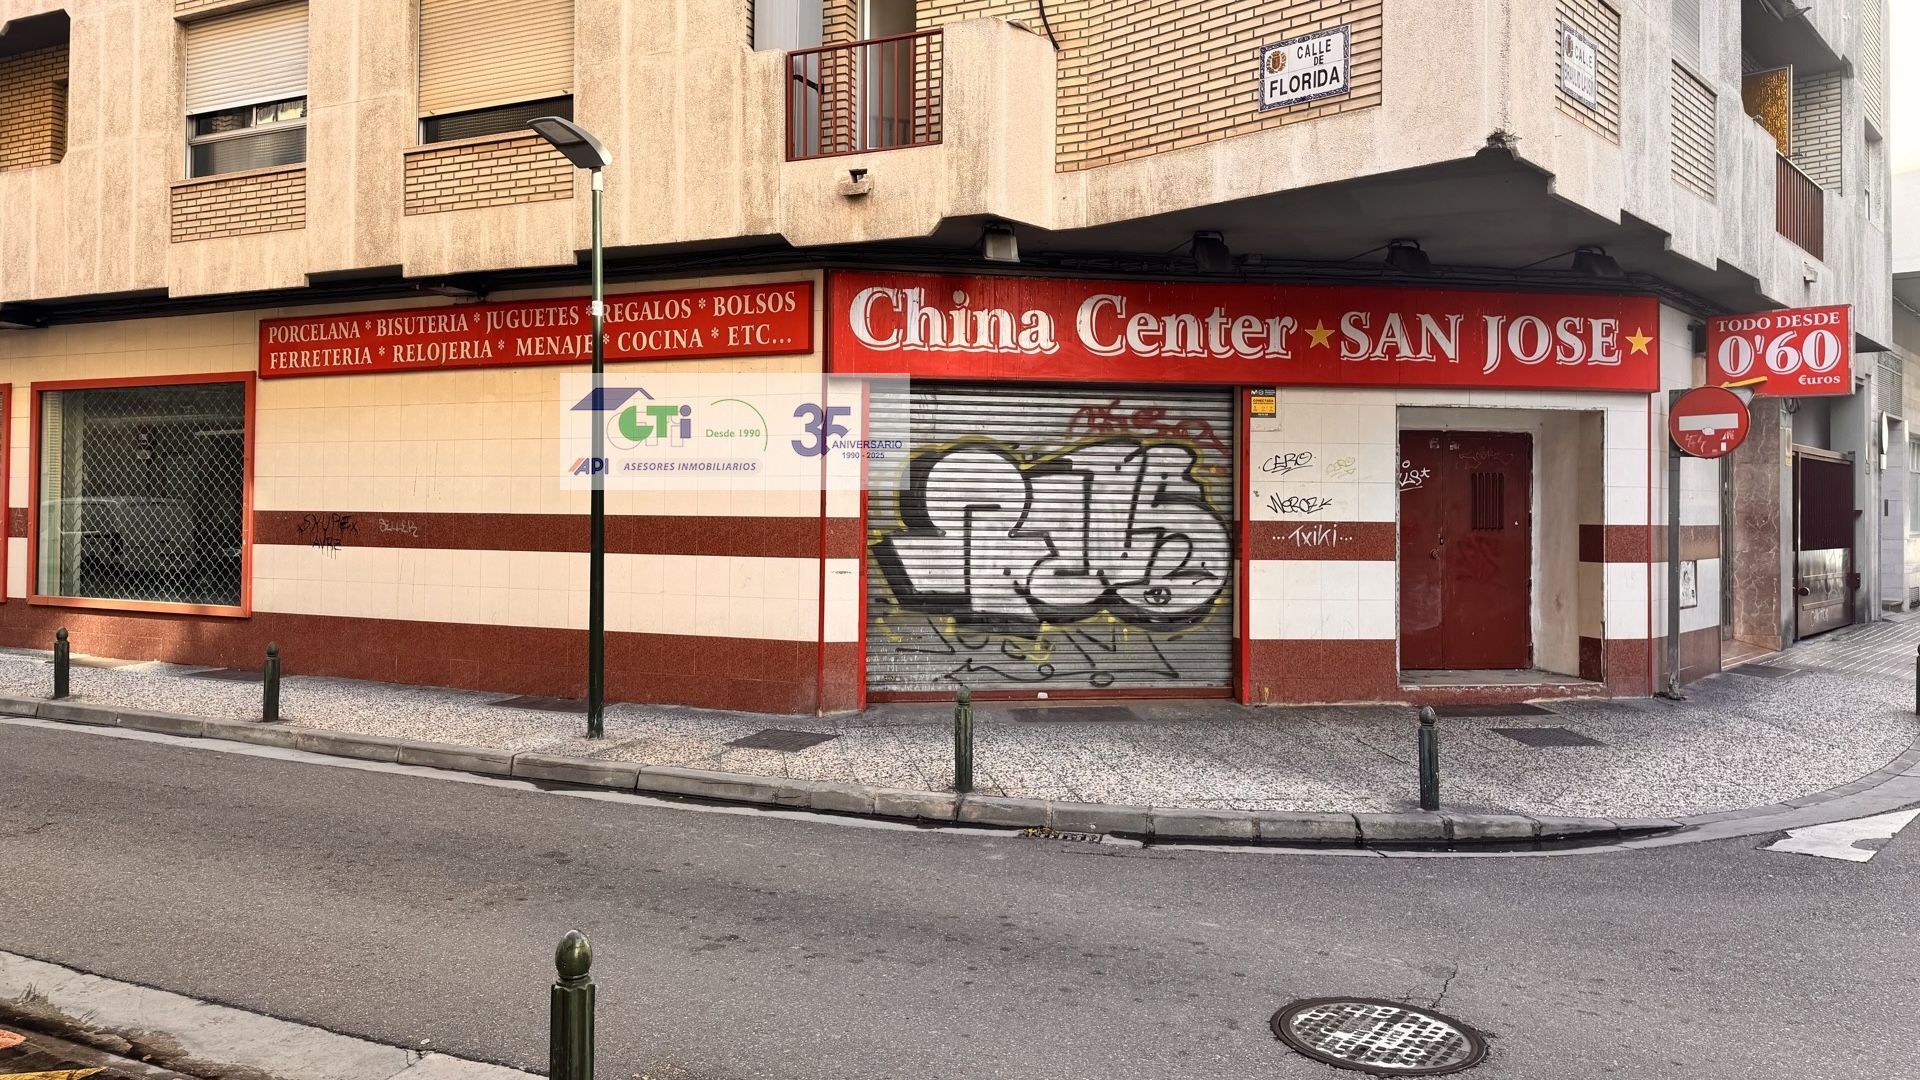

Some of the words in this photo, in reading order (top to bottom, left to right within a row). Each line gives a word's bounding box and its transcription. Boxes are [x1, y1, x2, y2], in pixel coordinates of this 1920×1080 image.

[1297, 39, 1331, 59] CALLE
[1313, 55, 1324, 66] DE
[1269, 66, 1340, 98] FLORIDA
[268, 321, 361, 344] PORCELANA
[376, 313, 469, 337] BISUTERIA
[486, 305, 579, 335] JUGUETES
[602, 298, 692, 324] REGALOS
[712, 291, 797, 317] BOLSOS
[849, 286, 1060, 354] China
[1075, 294, 1297, 359] Center
[1340, 311, 1464, 363] SAN
[1482, 315, 1622, 375] JOSE
[1716, 317, 1771, 332] TODO
[1776, 312, 1841, 329] DESDE
[269, 346, 373, 370] FERRETERIA
[392, 339, 493, 364] RELOJERIA
[516, 334, 594, 358] MENAJE
[617, 328, 704, 352] COCINA
[727, 324, 792, 346] ETC...
[1718, 329, 1842, 377] 0'60
[1798, 374, 1841, 385] €uros
